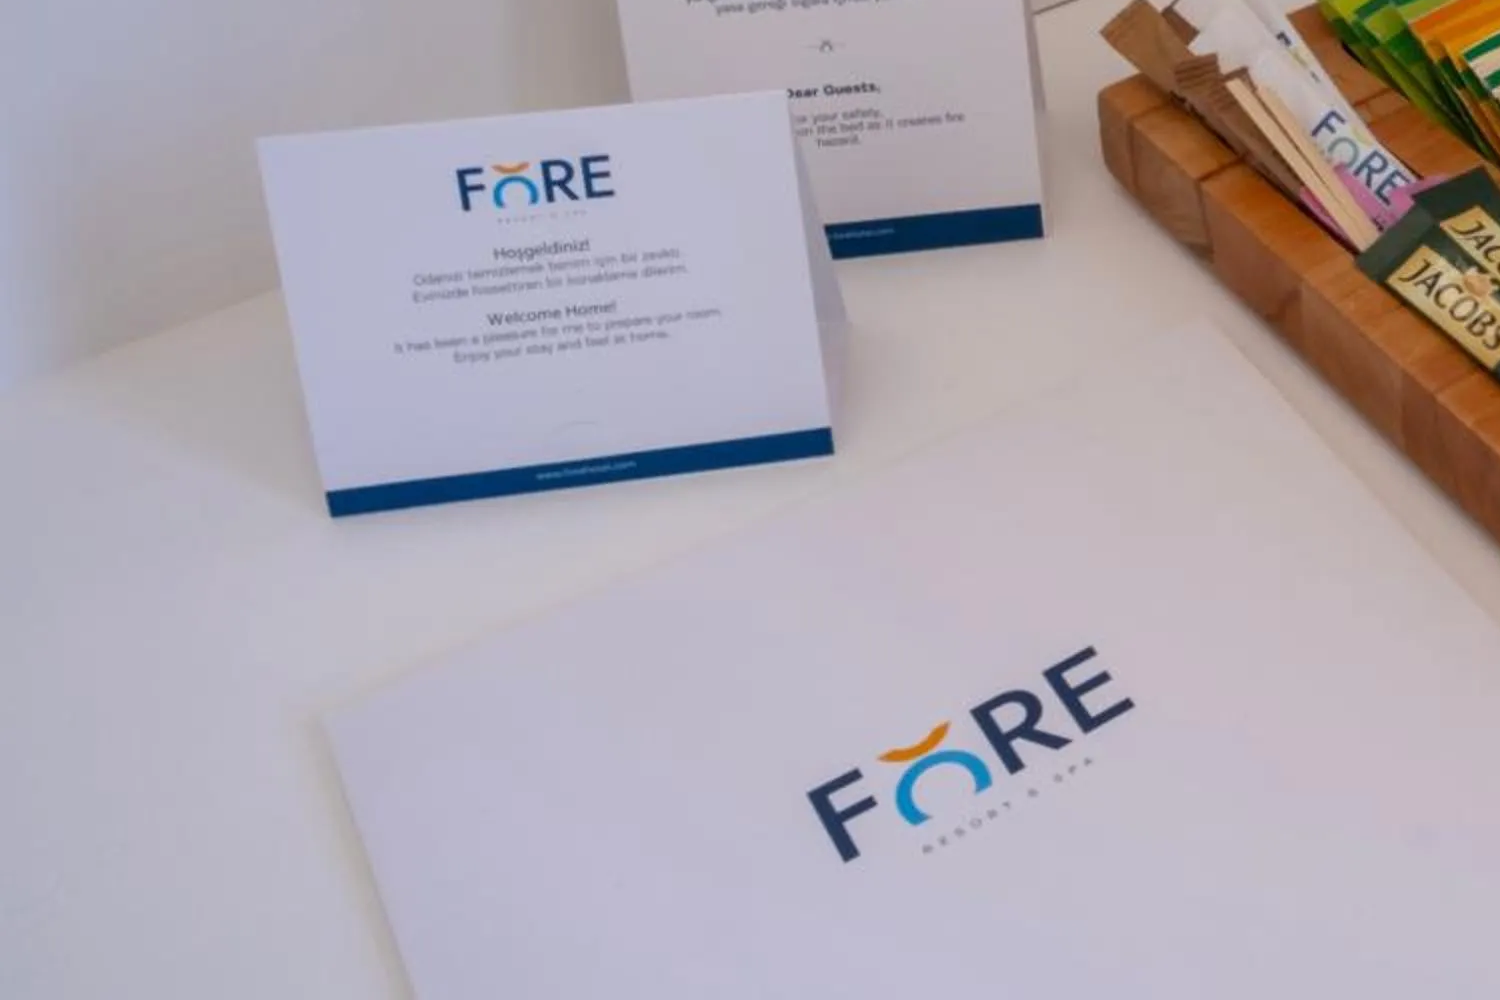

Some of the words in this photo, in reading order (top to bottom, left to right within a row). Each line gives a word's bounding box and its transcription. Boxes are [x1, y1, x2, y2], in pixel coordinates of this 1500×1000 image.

[823, 81, 881, 96] Guests,
[456, 155, 615, 212] FORE
[493, 239, 590, 263] Hoşgeldiniz!
[486, 308, 562, 327] Welcome
[564, 300, 618, 318] Home!
[806, 645, 1136, 864] FORE
